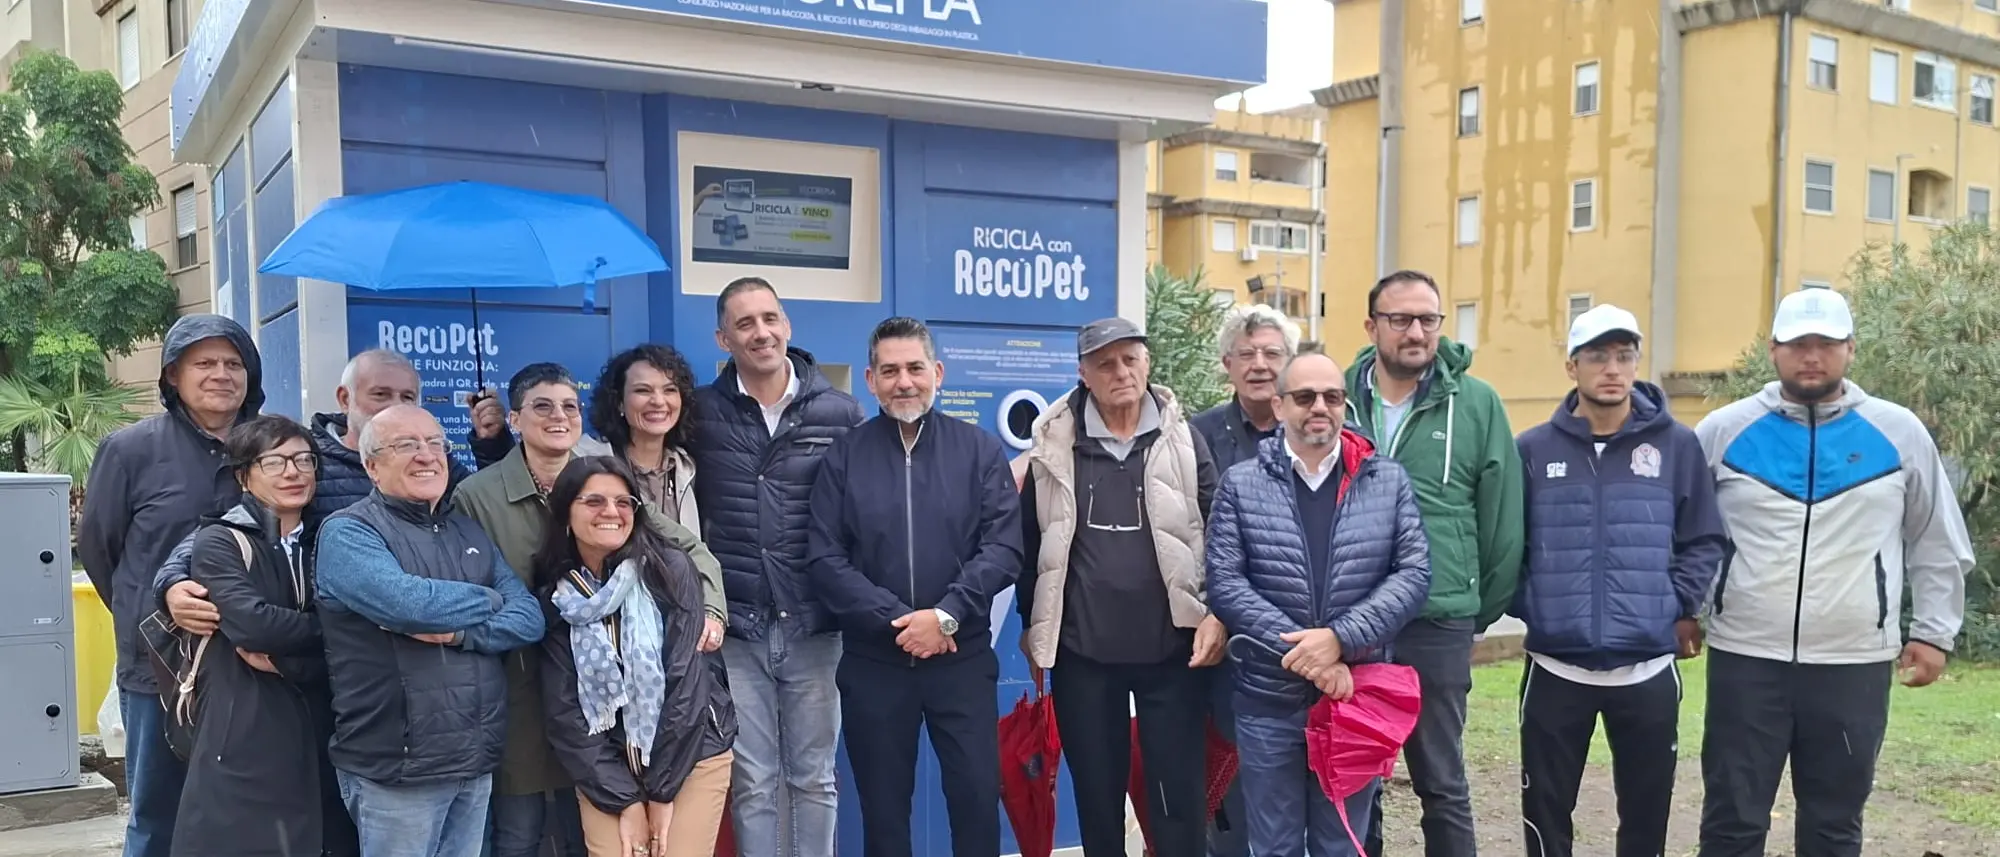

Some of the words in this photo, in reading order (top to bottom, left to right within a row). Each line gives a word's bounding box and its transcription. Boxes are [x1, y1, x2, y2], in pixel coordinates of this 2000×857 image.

[756, 204, 791, 214] RICICLA
[802, 207, 829, 217] VINCI
[974, 227, 1044, 250] RICICLA
[1048, 240, 1072, 253] con
[449, 378, 454, 387] il
[456, 379, 471, 388] QR
